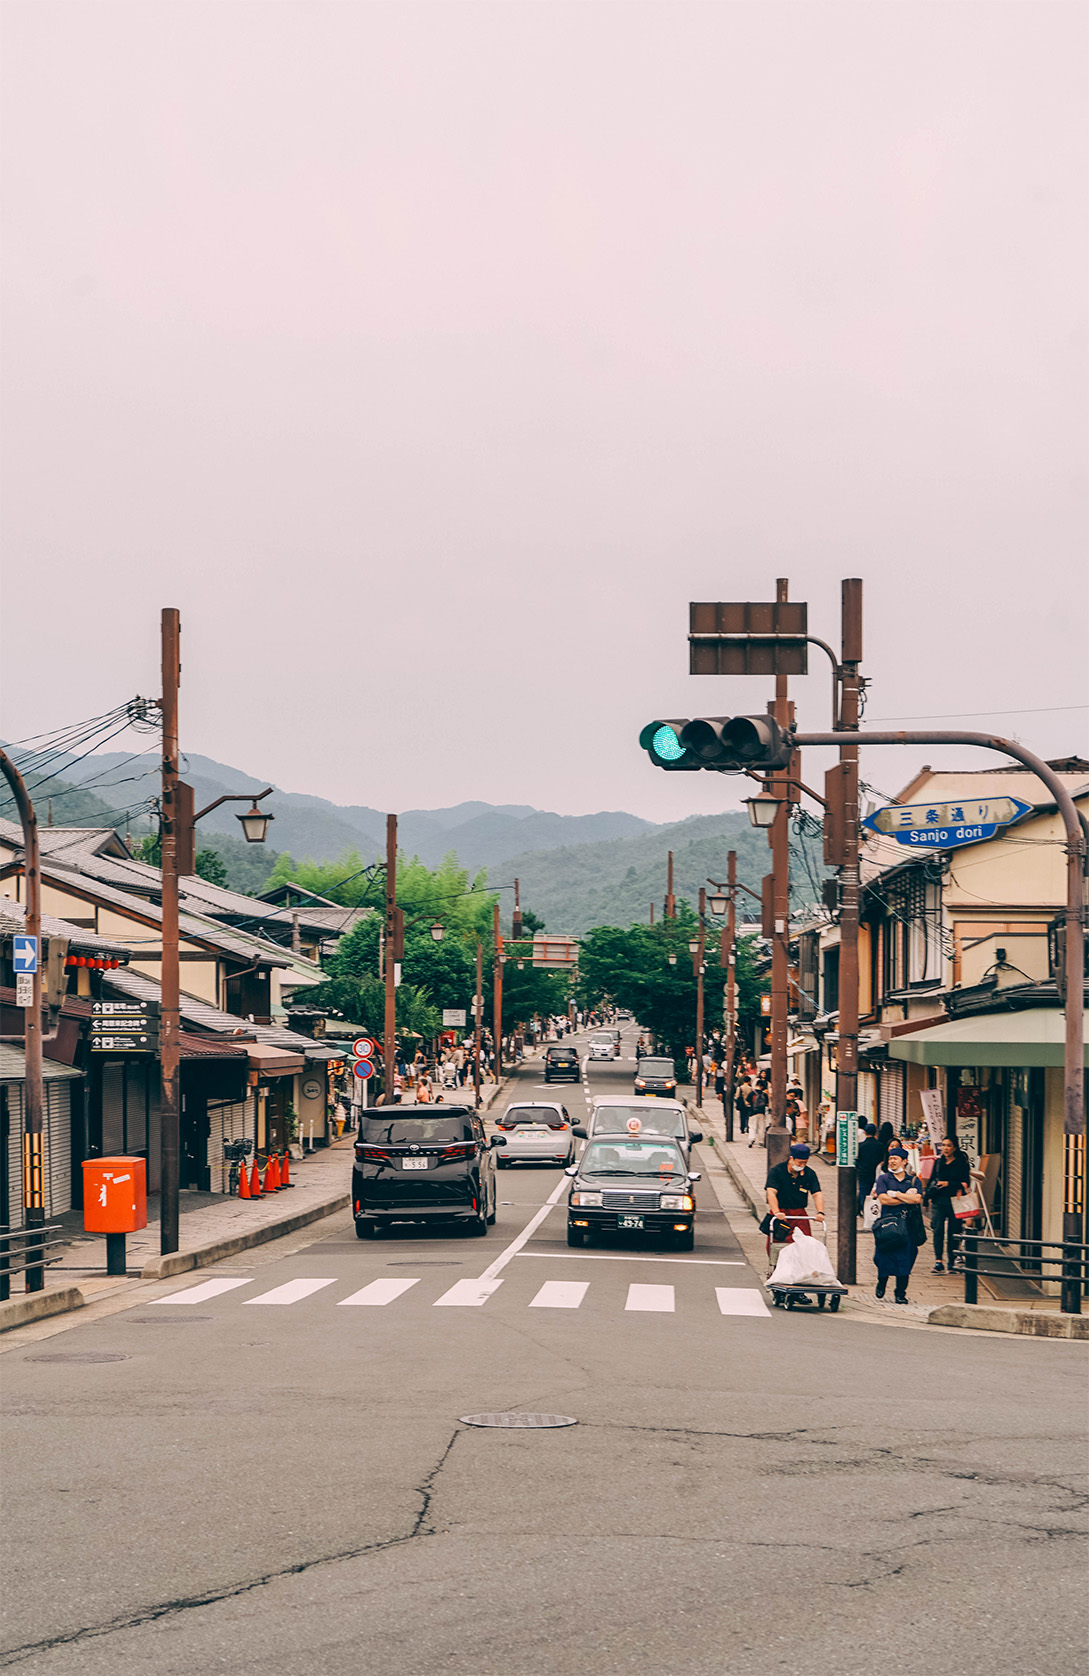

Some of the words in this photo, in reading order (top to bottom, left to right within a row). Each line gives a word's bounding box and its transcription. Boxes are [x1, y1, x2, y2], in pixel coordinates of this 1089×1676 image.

[900, 804, 989, 827] 三条通り
[910, 827, 948, 842] Sanjo
[956, 825, 982, 838] dori
[358, 1043, 369, 1053] 30
